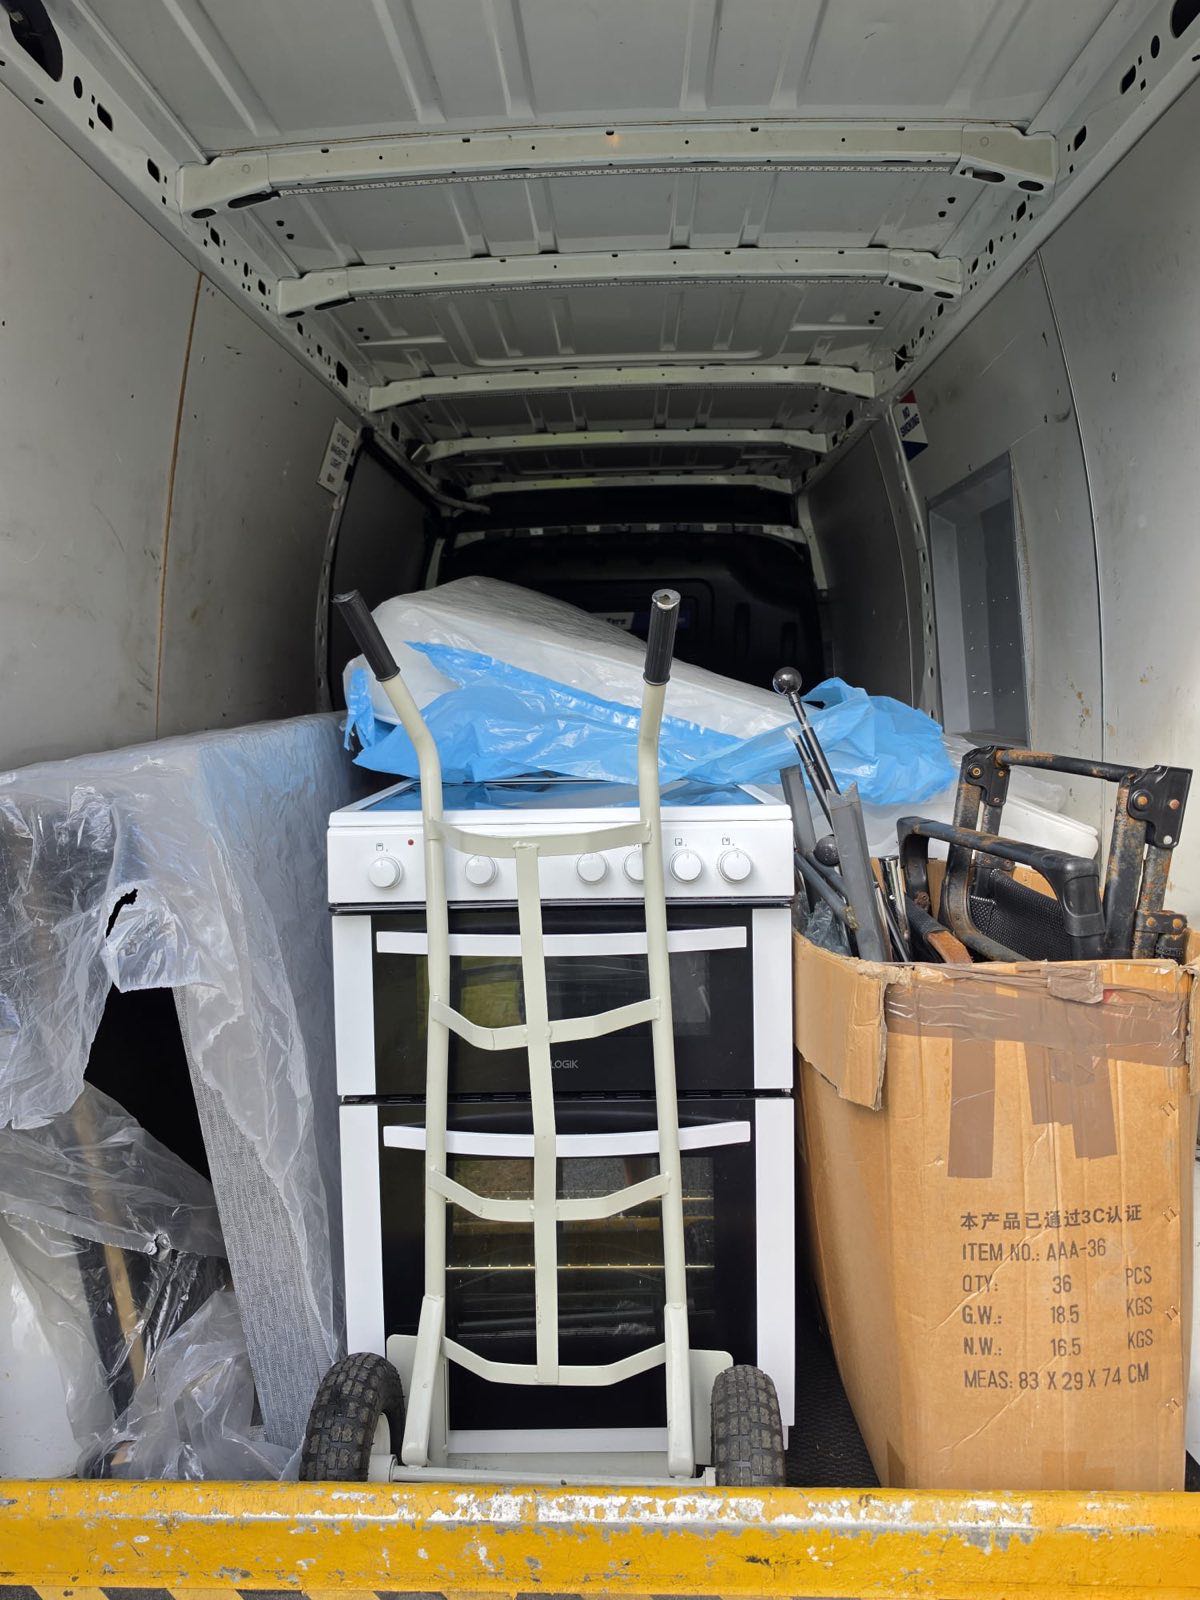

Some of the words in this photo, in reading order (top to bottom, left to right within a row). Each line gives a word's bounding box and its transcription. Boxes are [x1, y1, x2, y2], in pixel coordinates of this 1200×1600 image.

[960, 1204, 1142, 1230] 本产品已通过3C认证
[962, 1243, 1003, 1261] ITEM
[1009, 1243, 1040, 1261] NO.:
[1046, 1238, 1106, 1261] AAA-36
[962, 1275, 998, 1292] QTY:
[1052, 1275, 1072, 1293] 36
[1125, 1266, 1152, 1286] PCS
[962, 1305, 1002, 1324] G.W.:
[1050, 1305, 1079, 1324] 18.5
[1126, 1296, 1152, 1317] KGS
[963, 1337, 1002, 1356] N.W.:
[1050, 1338, 1081, 1356] 16.5
[1128, 1329, 1153, 1350] KGS
[964, 1370, 1013, 1388] MEAS:
[1019, 1371, 1039, 1390] 83
[1047, 1371, 1056, 1390] X
[1062, 1372, 1083, 1390] 29
[1088, 1369, 1096, 1388] X
[1102, 1366, 1121, 1387] 74
[1128, 1362, 1149, 1384] CM
